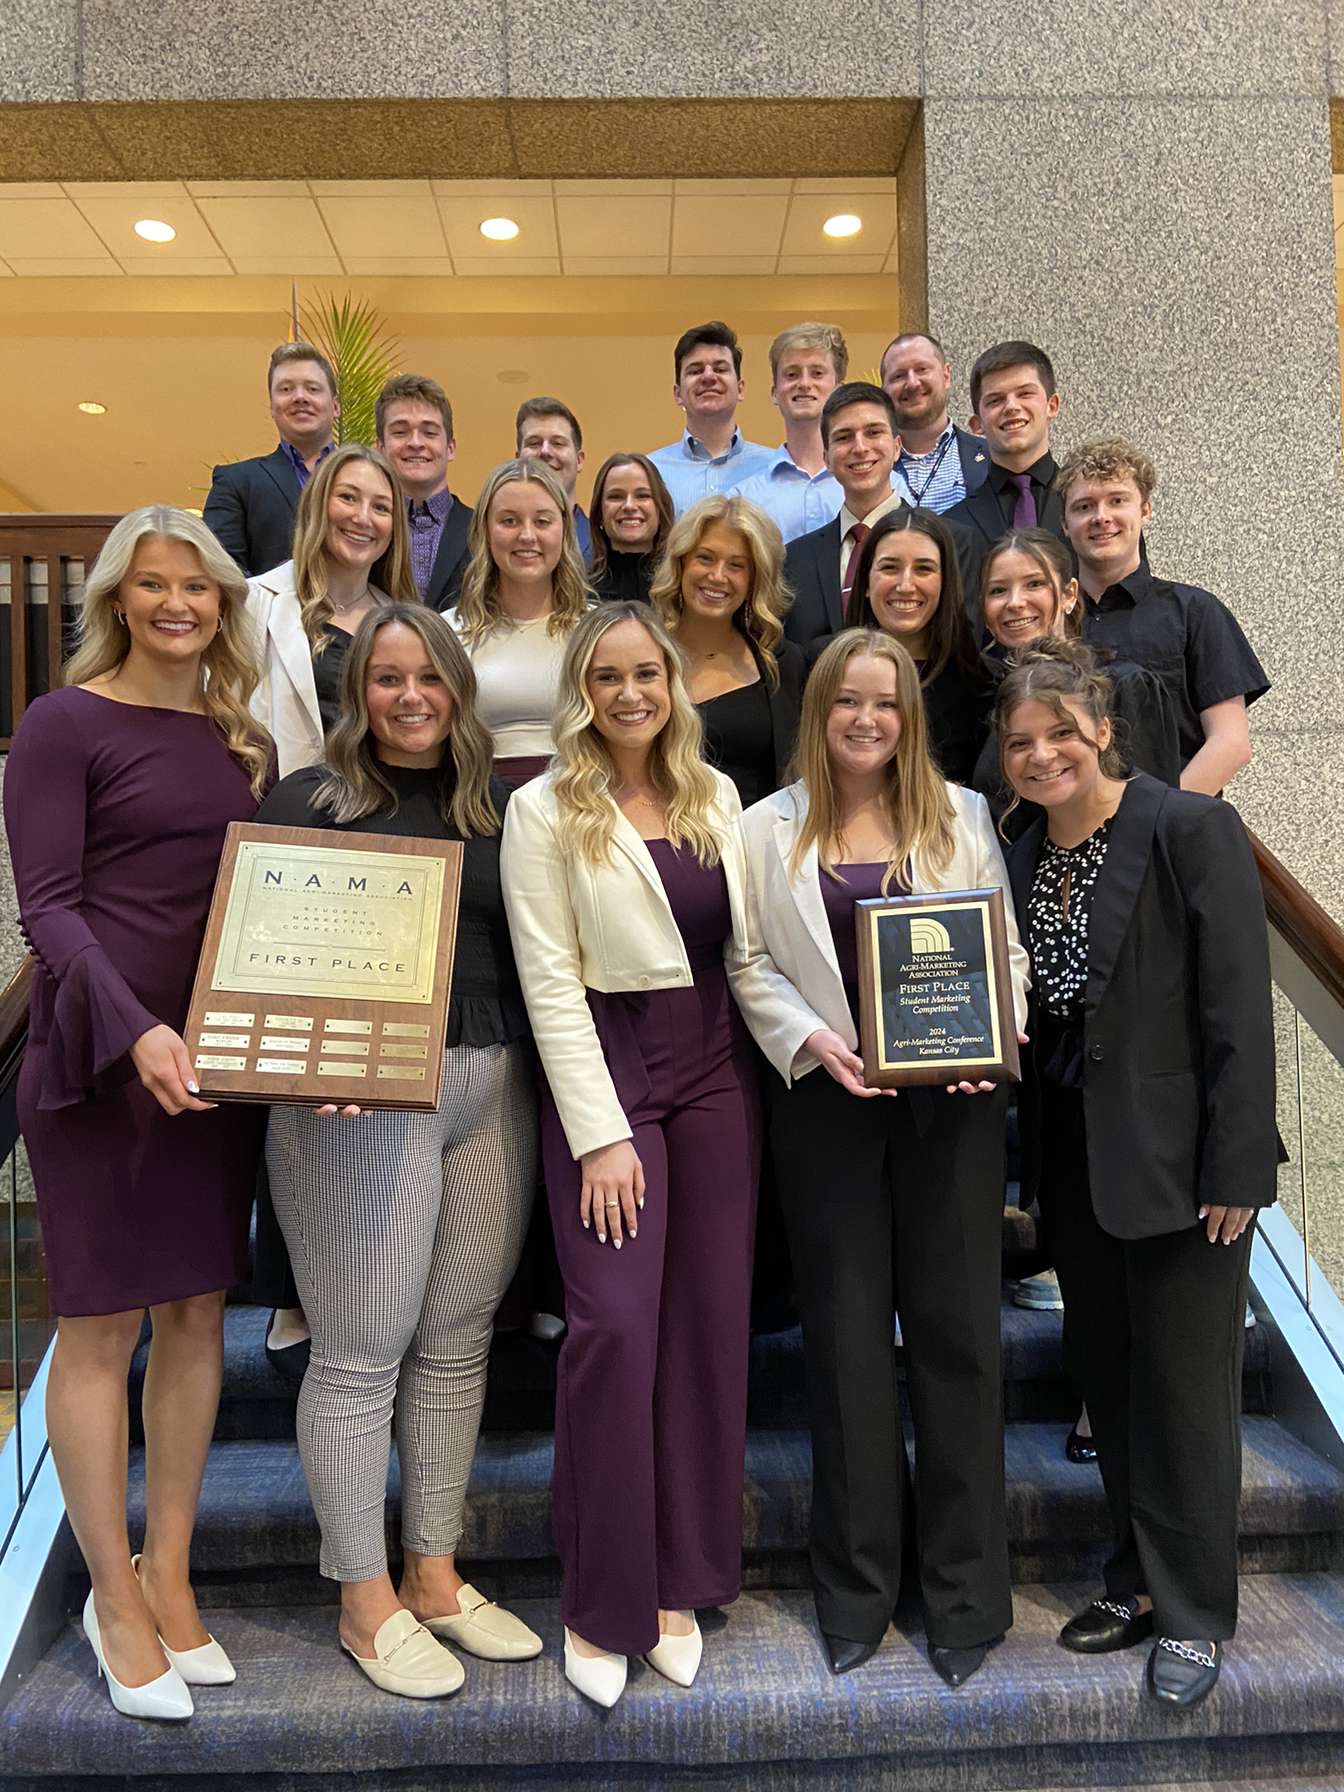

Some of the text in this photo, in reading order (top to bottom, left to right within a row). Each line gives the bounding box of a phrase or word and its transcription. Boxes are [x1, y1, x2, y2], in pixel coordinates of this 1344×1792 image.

[304, 907, 368, 916] STUDENT
[293, 915, 376, 926] MARKETING
[282, 925, 384, 936] COMPETITION
[249, 953, 407, 973] FIRST PLACE
[912, 954, 952, 963] NATIONAL
[900, 961, 967, 972] AGRI-MARKETING
[908, 969, 959, 979] ASSOCIATION
[899, 981, 971, 994] FIRST PLACE
[899, 994, 972, 1006] Student Marketing
[912, 1005, 959, 1016] Competition
[929, 1027, 947, 1036] 2024
[893, 1035, 985, 1048] Agri-Marketing Conference
[919, 1046, 960, 1056] Kansas City
